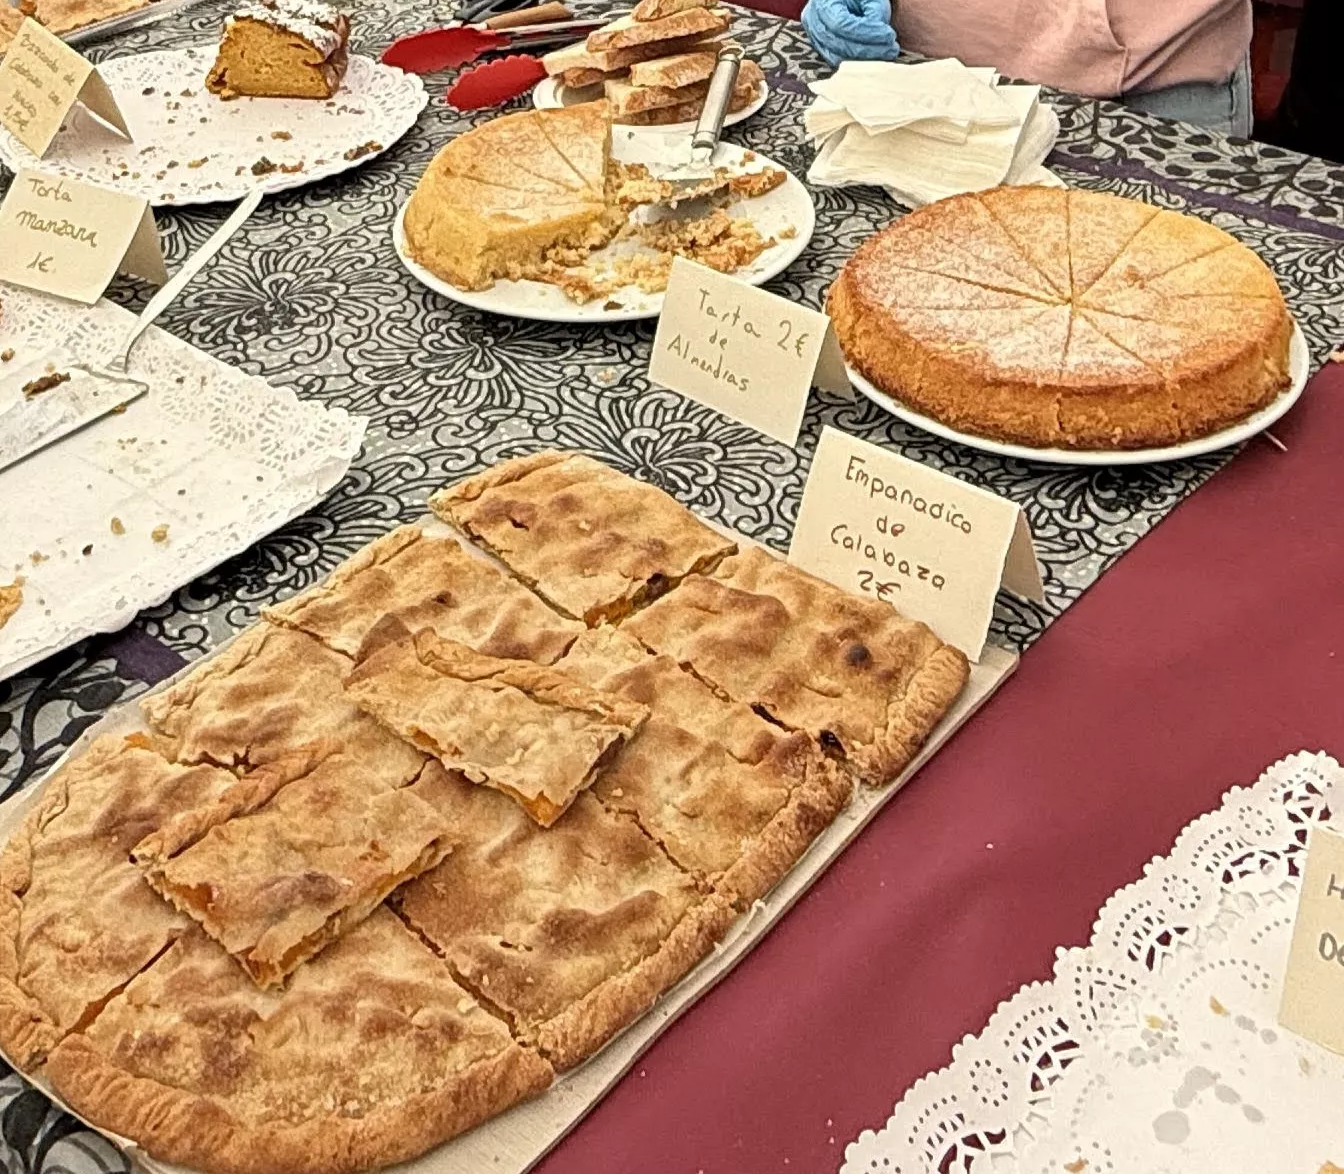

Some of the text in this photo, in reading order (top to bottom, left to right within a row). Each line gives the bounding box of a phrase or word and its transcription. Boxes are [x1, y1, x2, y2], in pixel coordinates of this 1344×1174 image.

[699, 288, 809, 358] Tarta 2€
[709, 330, 728, 350] de
[667, 334, 749, 391] Almendras
[845, 456, 972, 534] Empanadico
[876, 516, 905, 537] de
[831, 524, 945, 590] Calabaza
[857, 570, 901, 605] 2€
